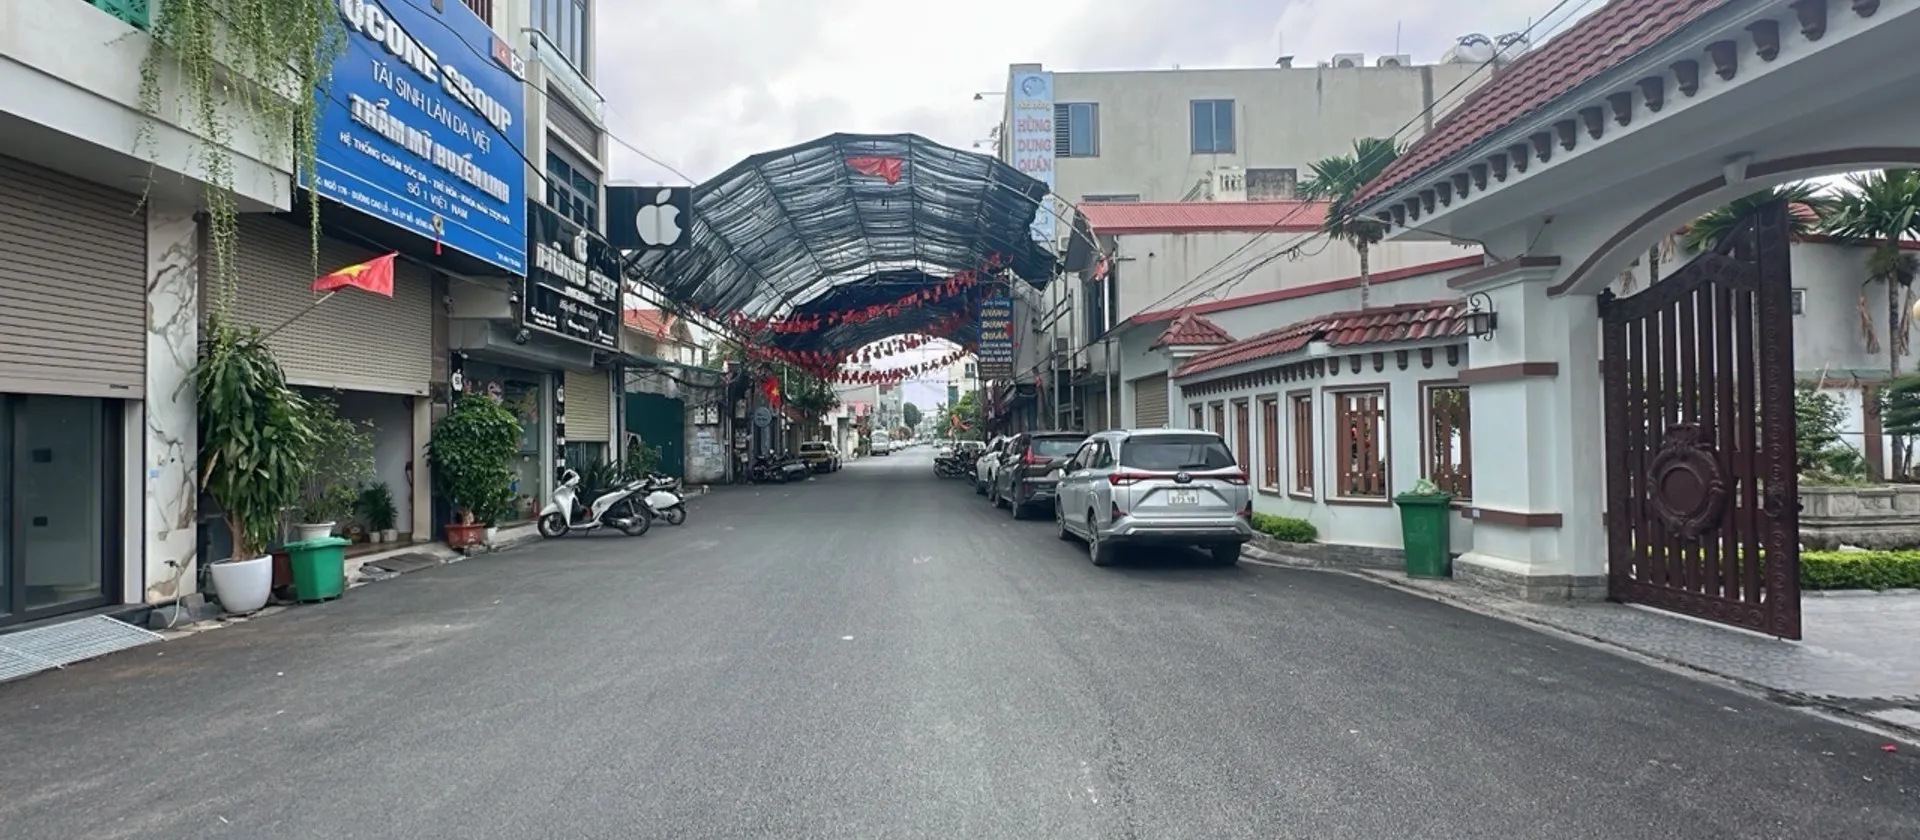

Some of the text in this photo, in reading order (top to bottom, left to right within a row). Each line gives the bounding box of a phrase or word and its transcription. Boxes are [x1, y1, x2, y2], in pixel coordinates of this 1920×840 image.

[396, 77, 425, 112] SINH
[427, 97, 452, 130] LÀN
[453, 115, 470, 141] DA
[472, 127, 491, 154] VIỆT
[441, 65, 512, 133] GROUP
[1017, 115, 1052, 132] HÙNG
[1017, 139, 1052, 152] DUNG
[407, 182, 420, 197] SỐ
[423, 191, 428, 200] 1
[451, 203, 468, 219] NAM
